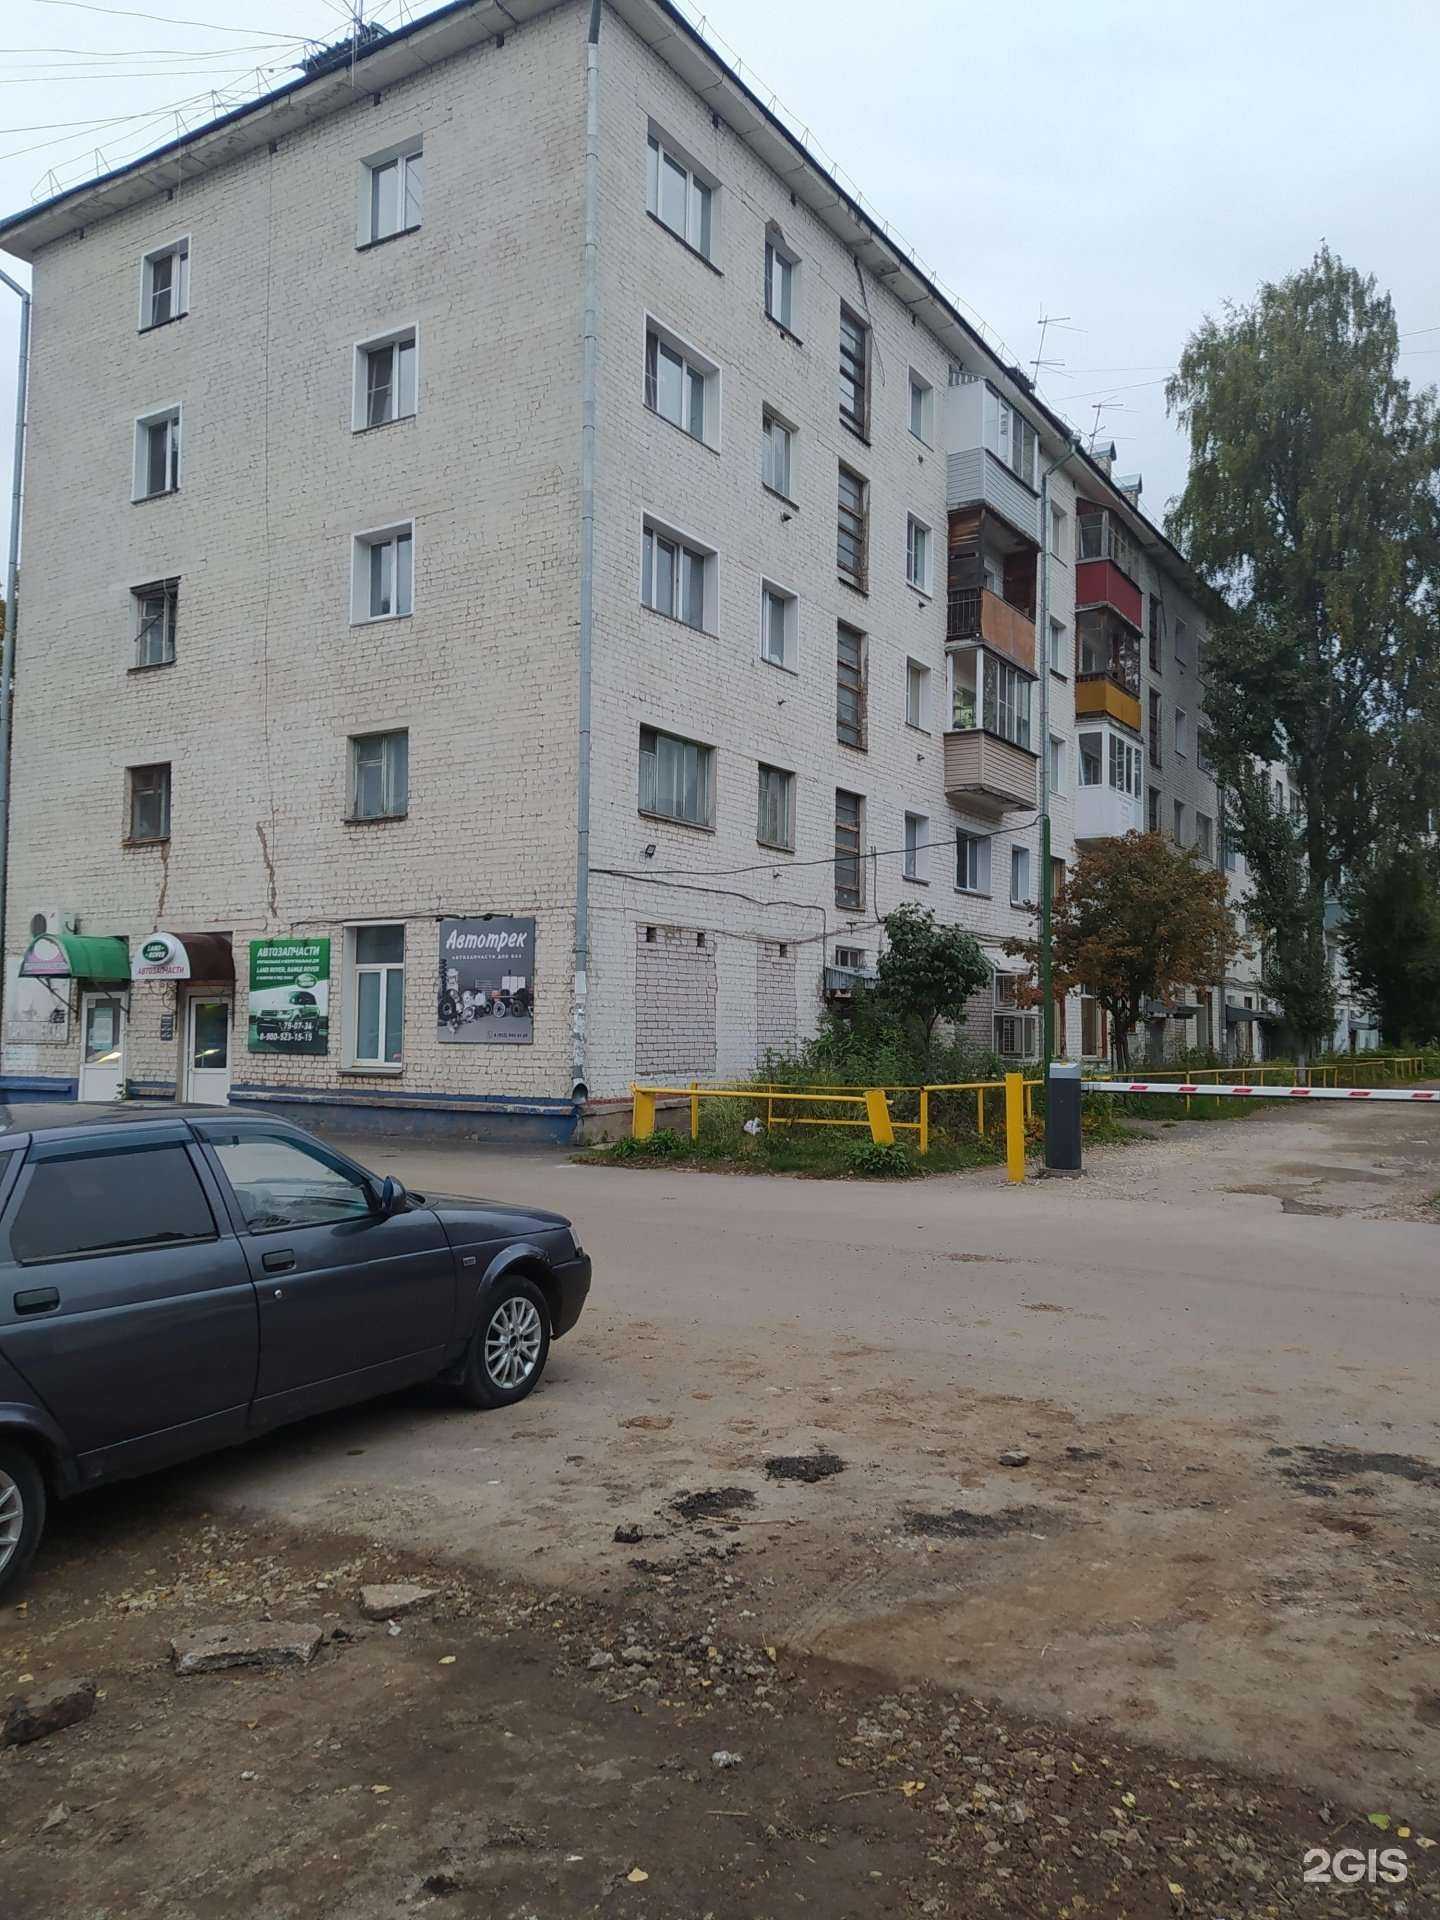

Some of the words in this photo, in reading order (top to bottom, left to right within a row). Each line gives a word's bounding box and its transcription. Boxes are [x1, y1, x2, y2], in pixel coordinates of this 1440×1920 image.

[446, 929, 528, 952] Автотрек
[257, 946, 320, 957] АВТОЗАПЧАСТИ
[137, 966, 184, 975] АВТОЗАПЧАСТИ
